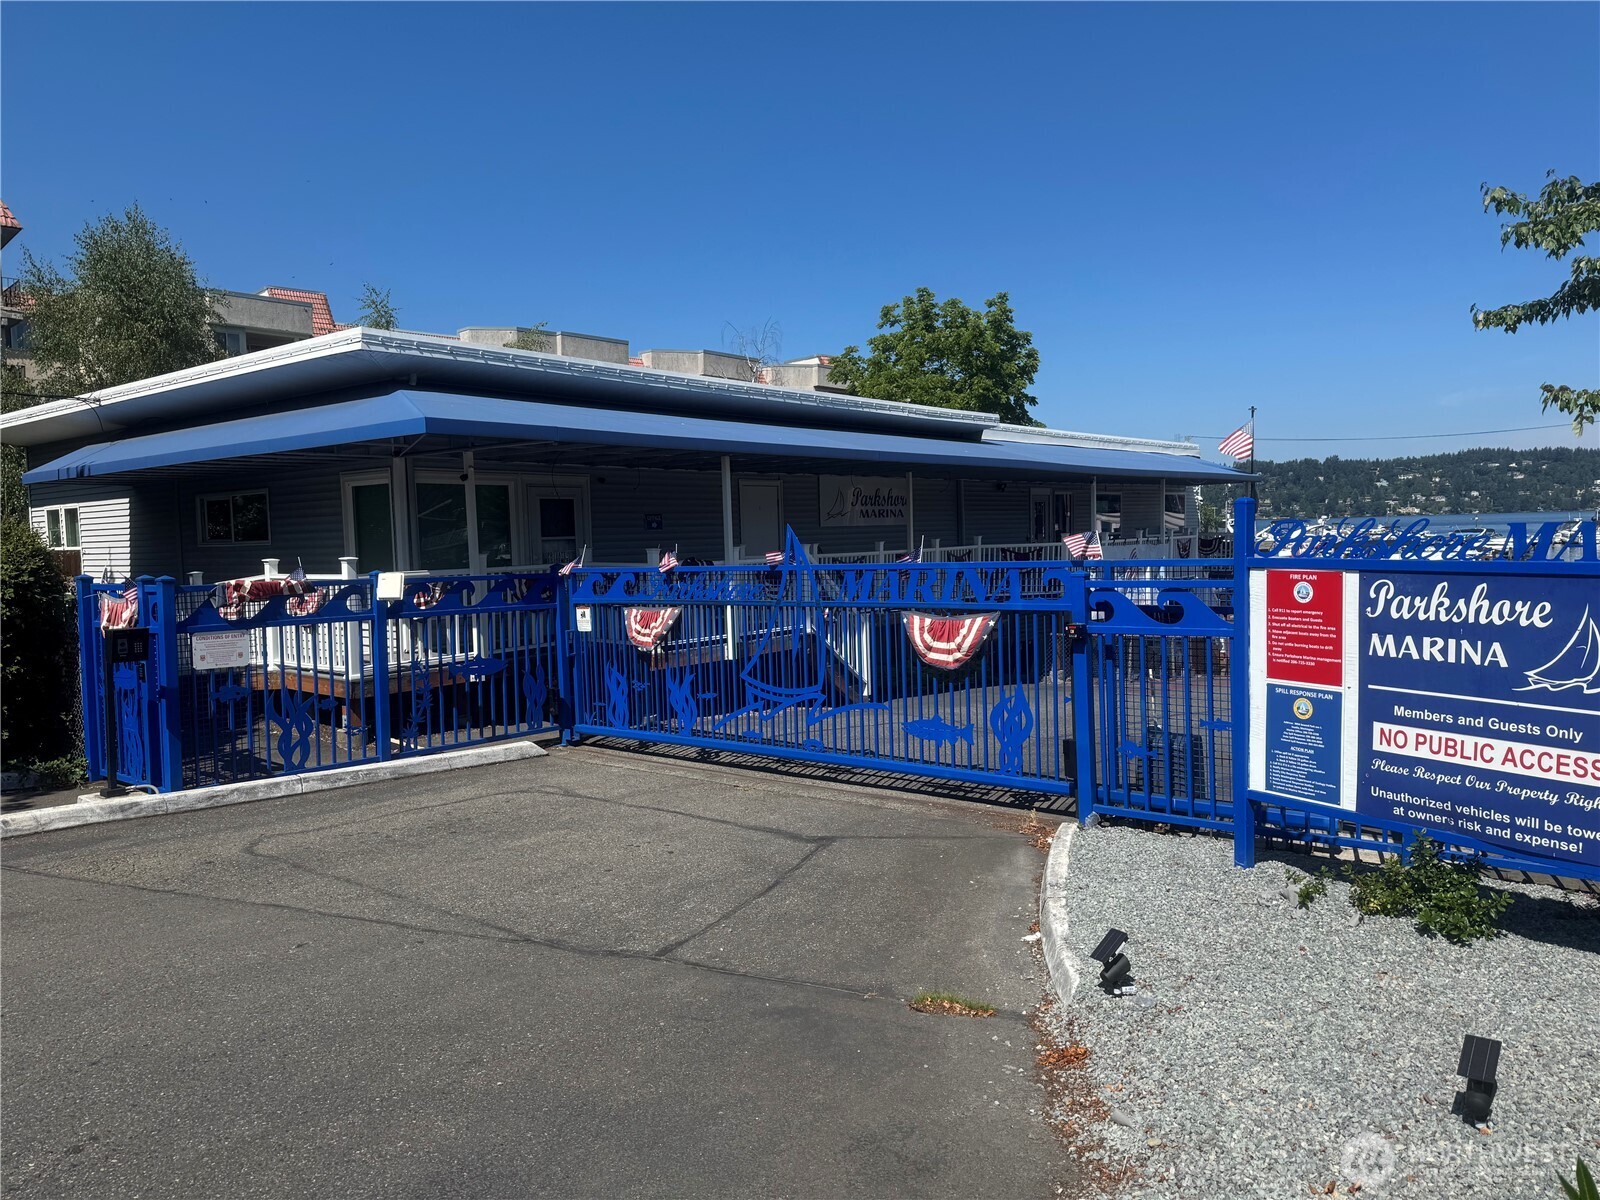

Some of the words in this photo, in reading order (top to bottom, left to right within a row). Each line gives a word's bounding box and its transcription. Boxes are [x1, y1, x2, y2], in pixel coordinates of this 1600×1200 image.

[851, 487, 907, 506] Parkshor
[859, 508, 904, 518] MARINA
[1254, 517, 1492, 560] Parkshore
[834, 568, 1022, 602] MARINA
[1365, 579, 1553, 628] Parkshore
[1368, 632, 1509, 668] MARINA
[1289, 689, 1317, 698] RESPONSE
[1394, 705, 1454, 724] Members
[1458, 716, 1484, 728] and
[1488, 718, 1541, 735] Guests
[1546, 725, 1583, 743] Only
[1380, 727, 1408, 749] NO
[1415, 733, 1495, 764] PUBLIC
[1371, 758, 1410, 775] Please
[1413, 766, 1461, 785] Respect
[1465, 775, 1492, 790] Our
[1495, 780, 1559, 806] Property
[1371, 786, 1452, 811] Unauthorized
[1455, 805, 1511, 823] vehicles
[1515, 816, 1539, 829] will
[1544, 820, 1563, 833] be
[1393, 806, 1404, 816] at
[1408, 810, 1454, 825] owners
[1458, 818, 1482, 832] risk
[1485, 826, 1511, 839] and
[1515, 832, 1583, 854] expense!
